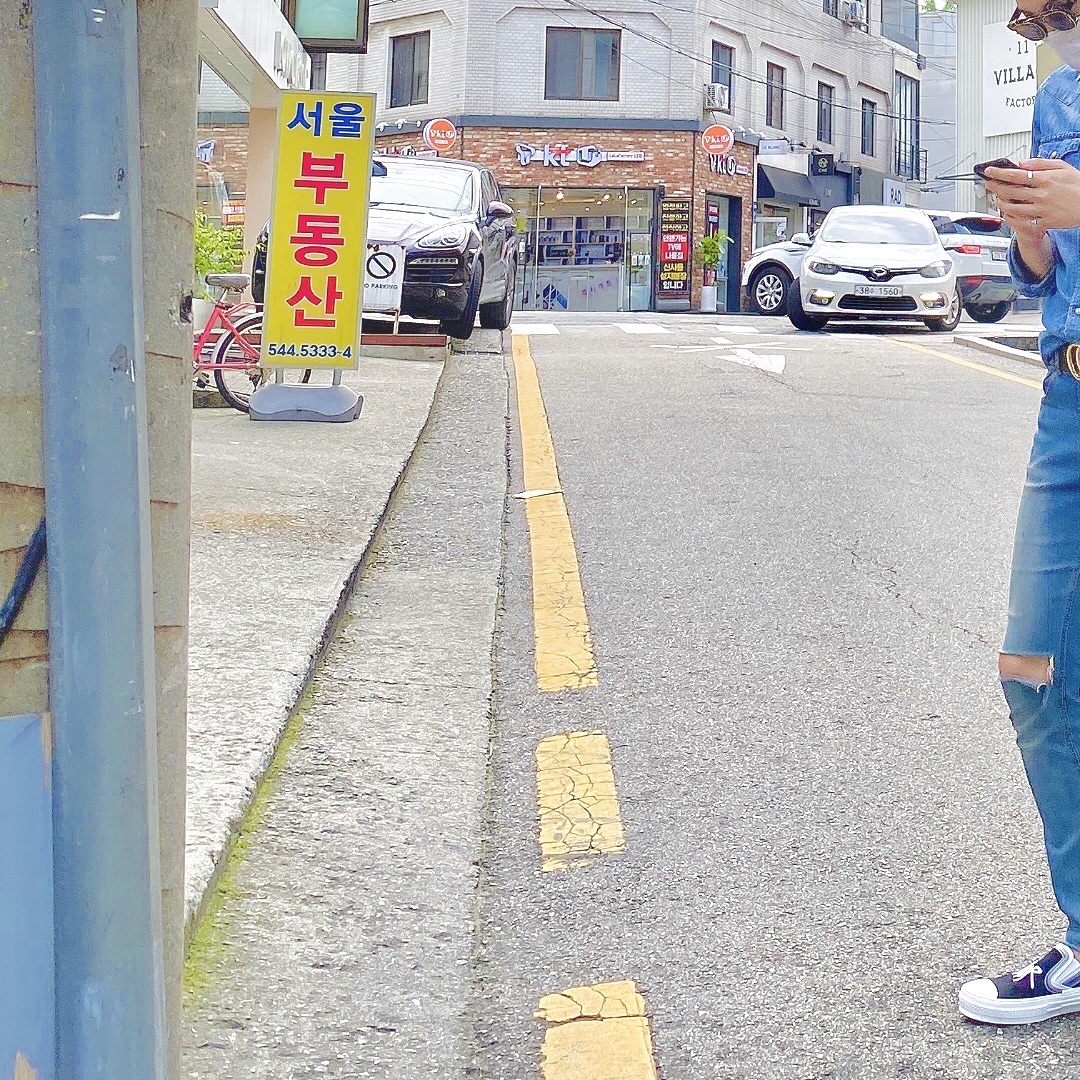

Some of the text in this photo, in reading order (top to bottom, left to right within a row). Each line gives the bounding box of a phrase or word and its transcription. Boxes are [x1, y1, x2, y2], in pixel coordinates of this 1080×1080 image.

[286, 101, 366, 138] 서울
[285, 151, 350, 329] 부동산
[878, 286, 899, 296] 1560
